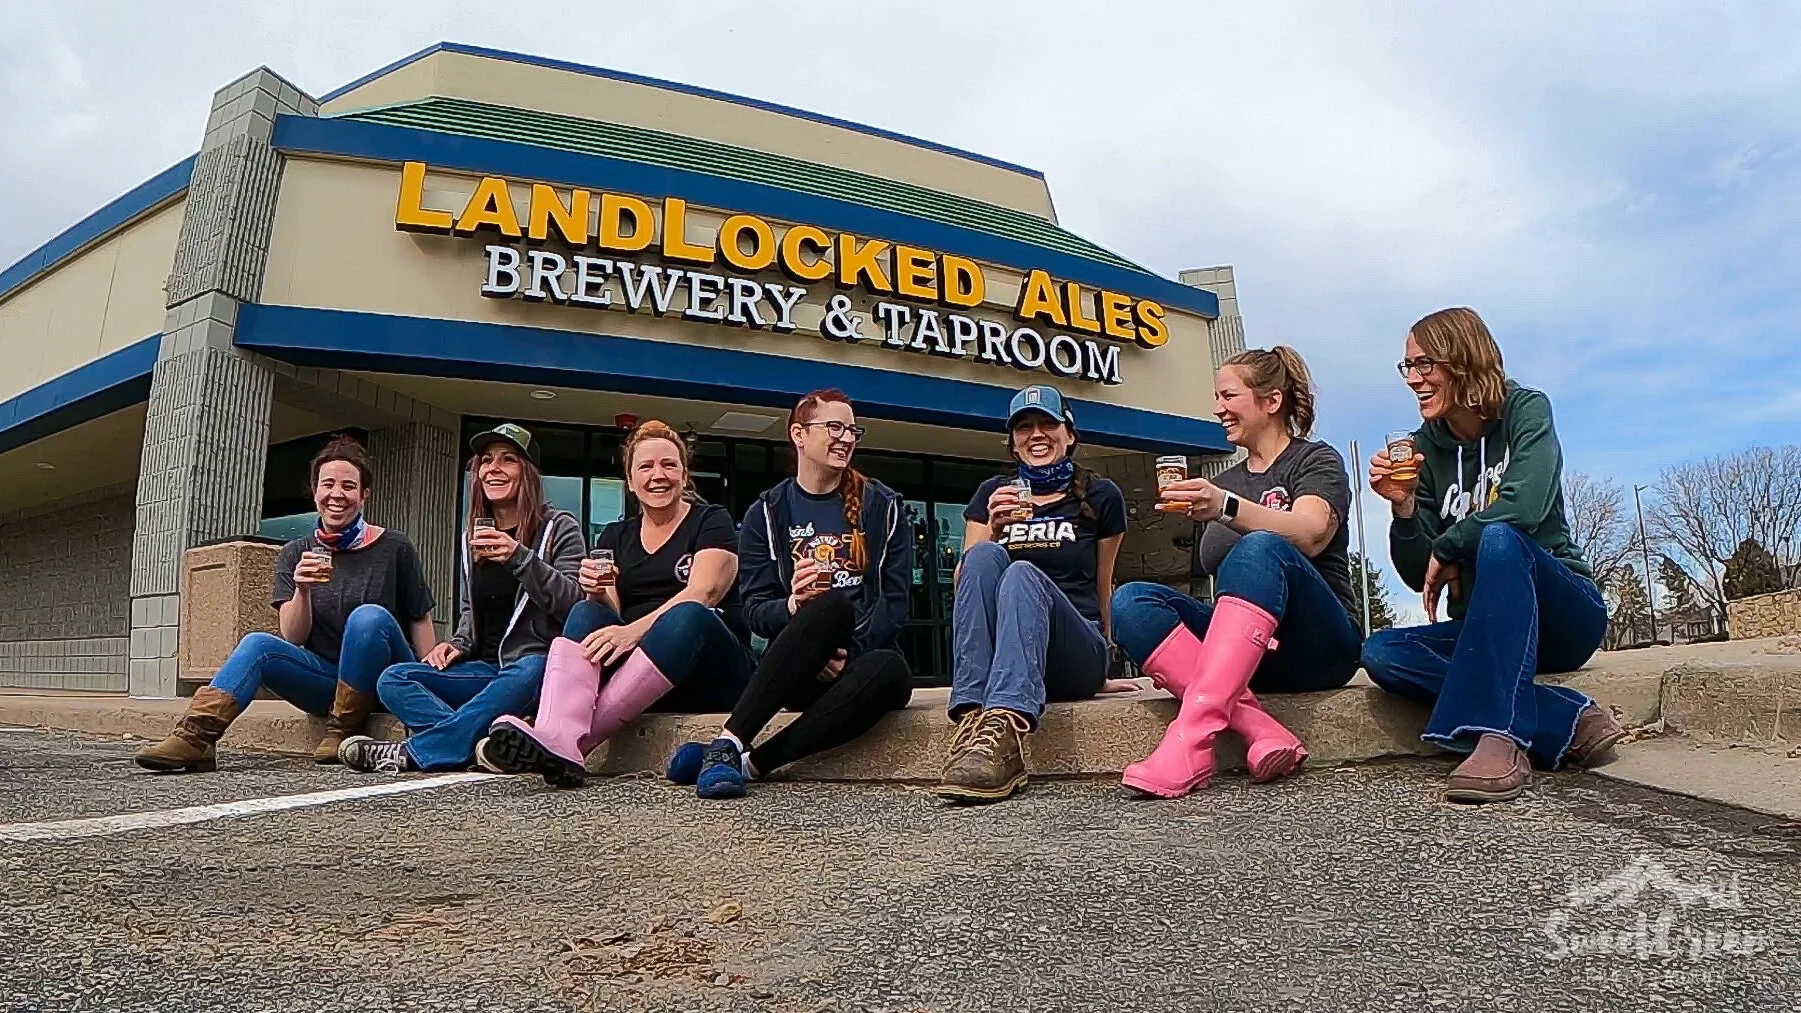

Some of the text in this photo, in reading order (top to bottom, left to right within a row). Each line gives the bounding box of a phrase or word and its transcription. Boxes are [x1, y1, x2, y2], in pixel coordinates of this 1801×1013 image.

[396, 161, 1168, 347] LANDLOCKED ALES
[482, 245, 1123, 384] BREWERY & TAPROOM
